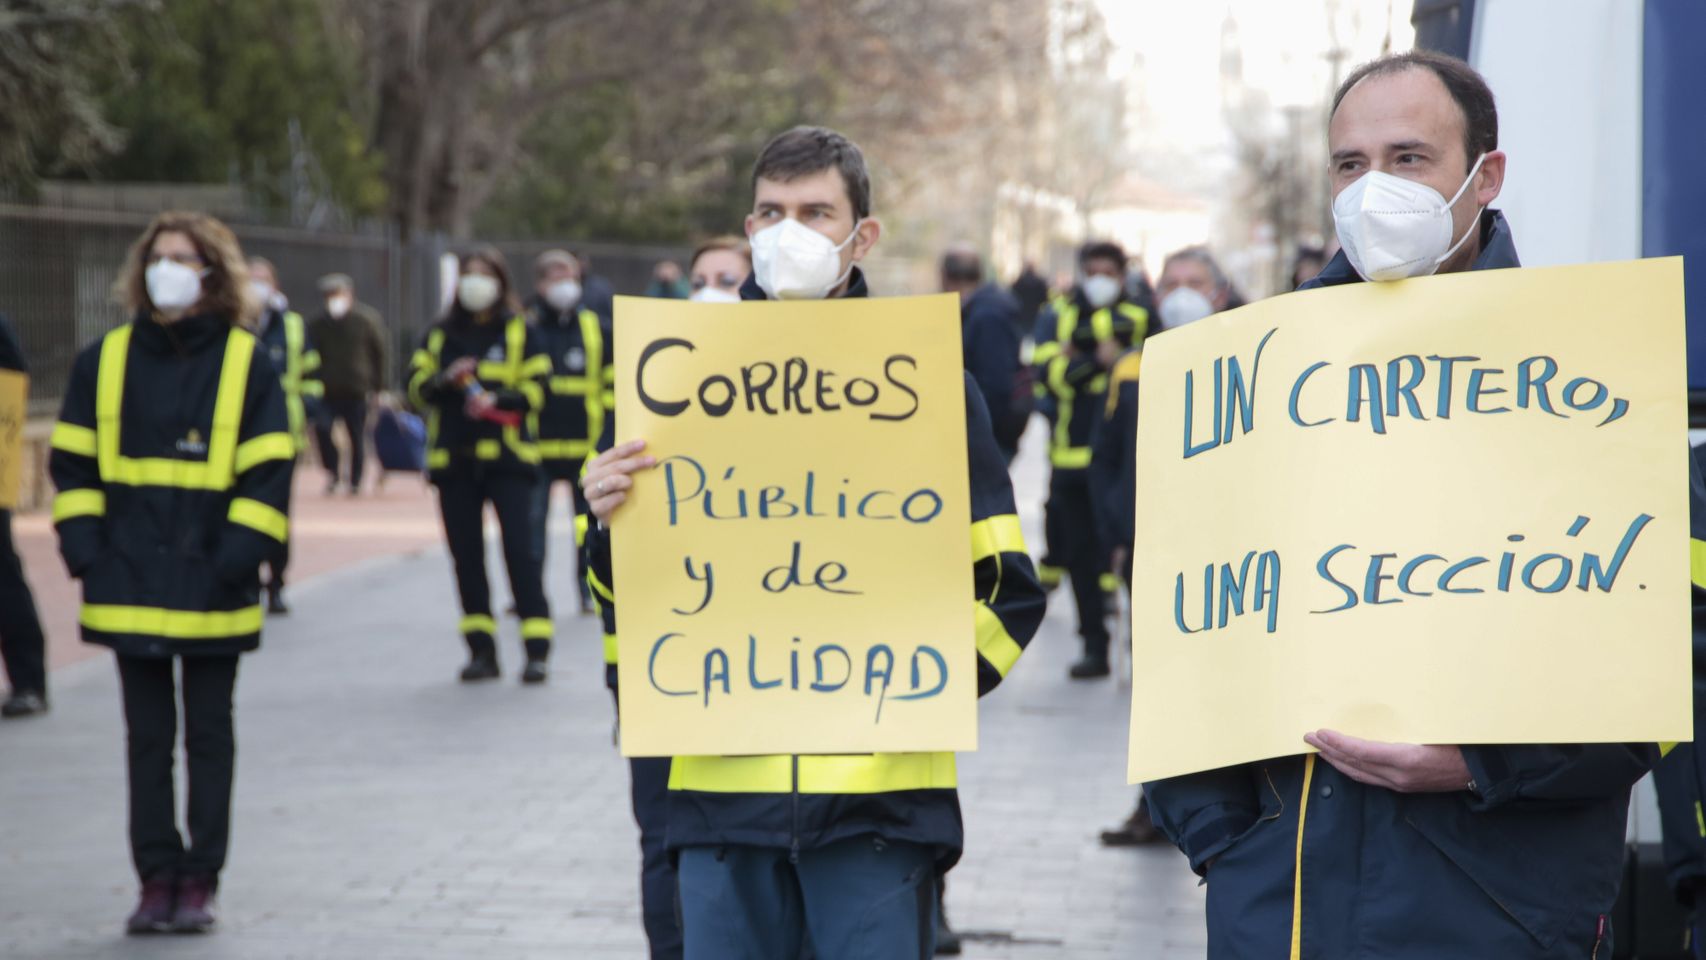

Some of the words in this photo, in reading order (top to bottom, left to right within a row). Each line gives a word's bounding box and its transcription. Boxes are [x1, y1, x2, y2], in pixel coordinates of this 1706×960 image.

[1183, 327, 1279, 459] UN
[1288, 353, 1630, 436] CARTERO,
[761, 541, 865, 594] de
[1174, 549, 1281, 634] UNA
